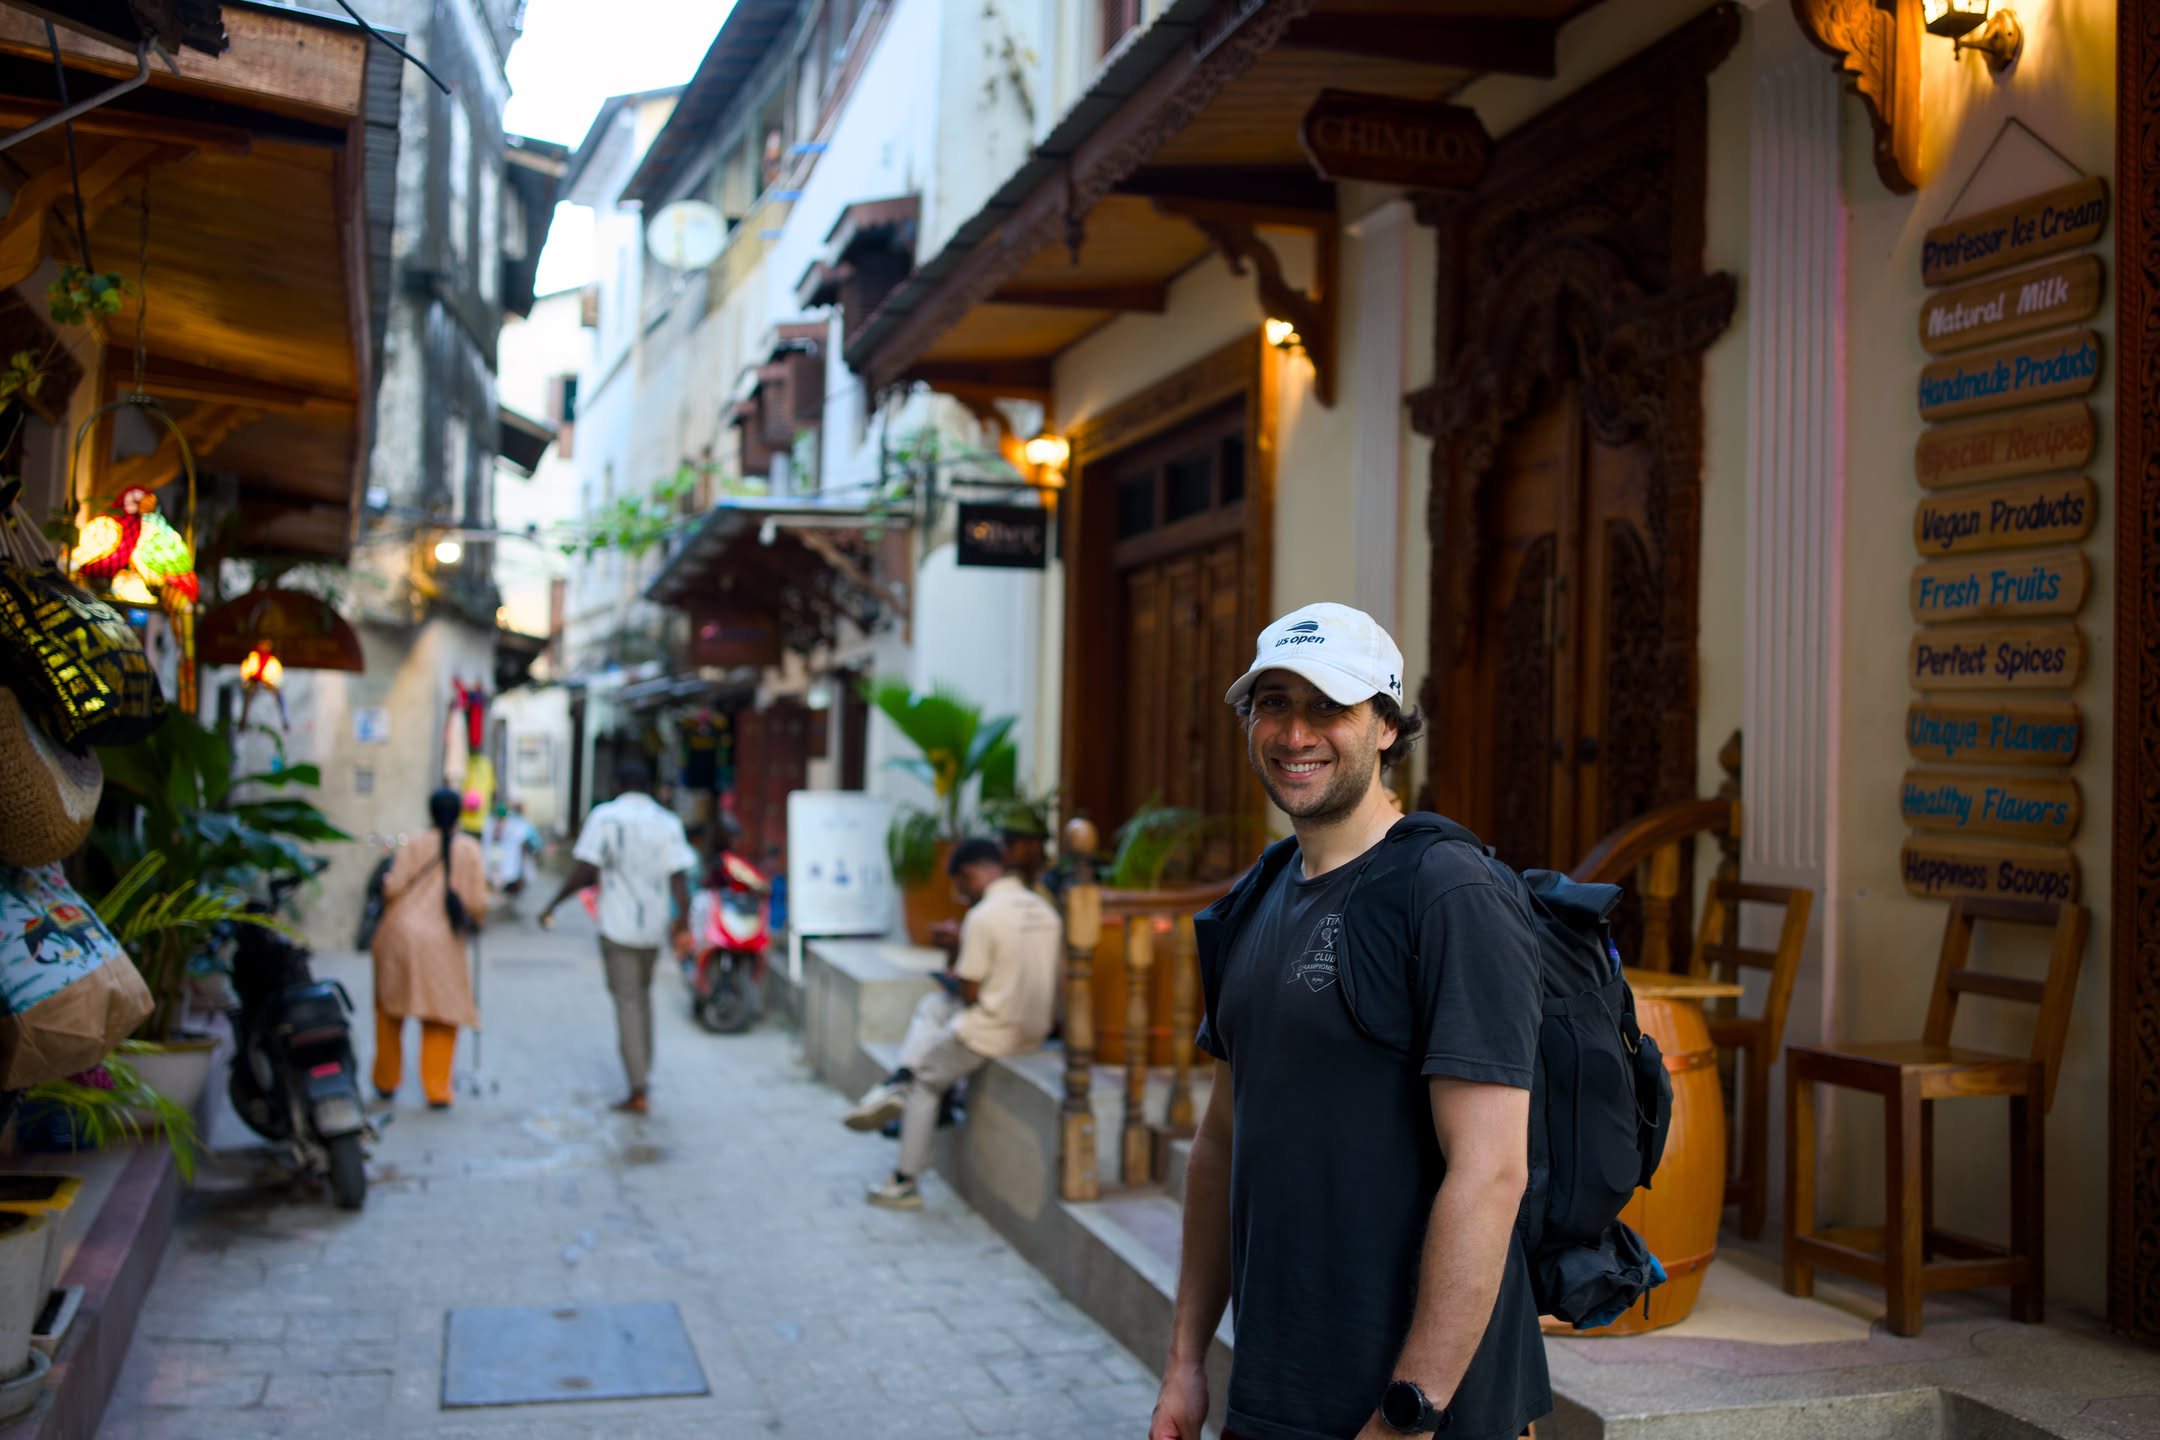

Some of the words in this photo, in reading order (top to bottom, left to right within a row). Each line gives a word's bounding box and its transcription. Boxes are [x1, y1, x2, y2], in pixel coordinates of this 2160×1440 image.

[1921, 228, 2008, 275] Professor
[2010, 215, 2036, 248] Ice
[2040, 198, 2104, 239] Cream
[1926, 292, 2005, 338] Natural
[2016, 275, 2071, 316] Milk
[1918, 360, 2011, 409] Handmade
[2014, 340, 2097, 390] Products
[1920, 434, 1996, 480] Special
[2005, 421, 2091, 464] Recipes
[1921, 508, 1981, 549] Vegan
[1990, 492, 2085, 534] Products
[1919, 573, 1981, 609] Fresh
[1990, 567, 2061, 605] Fruits
[1290, 635, 1326, 645] open
[1915, 643, 1988, 677] Perfect
[1994, 640, 2067, 682] Spices
[1909, 711, 1979, 758] Unique
[1988, 713, 2079, 754] Flavors
[1902, 783, 1974, 828] Healthy
[1981, 788, 2069, 826] Flavors
[1904, 850, 1988, 892] Happiness
[1996, 859, 2071, 902] Scoops
[1314, 952, 1337, 963] CLUB
